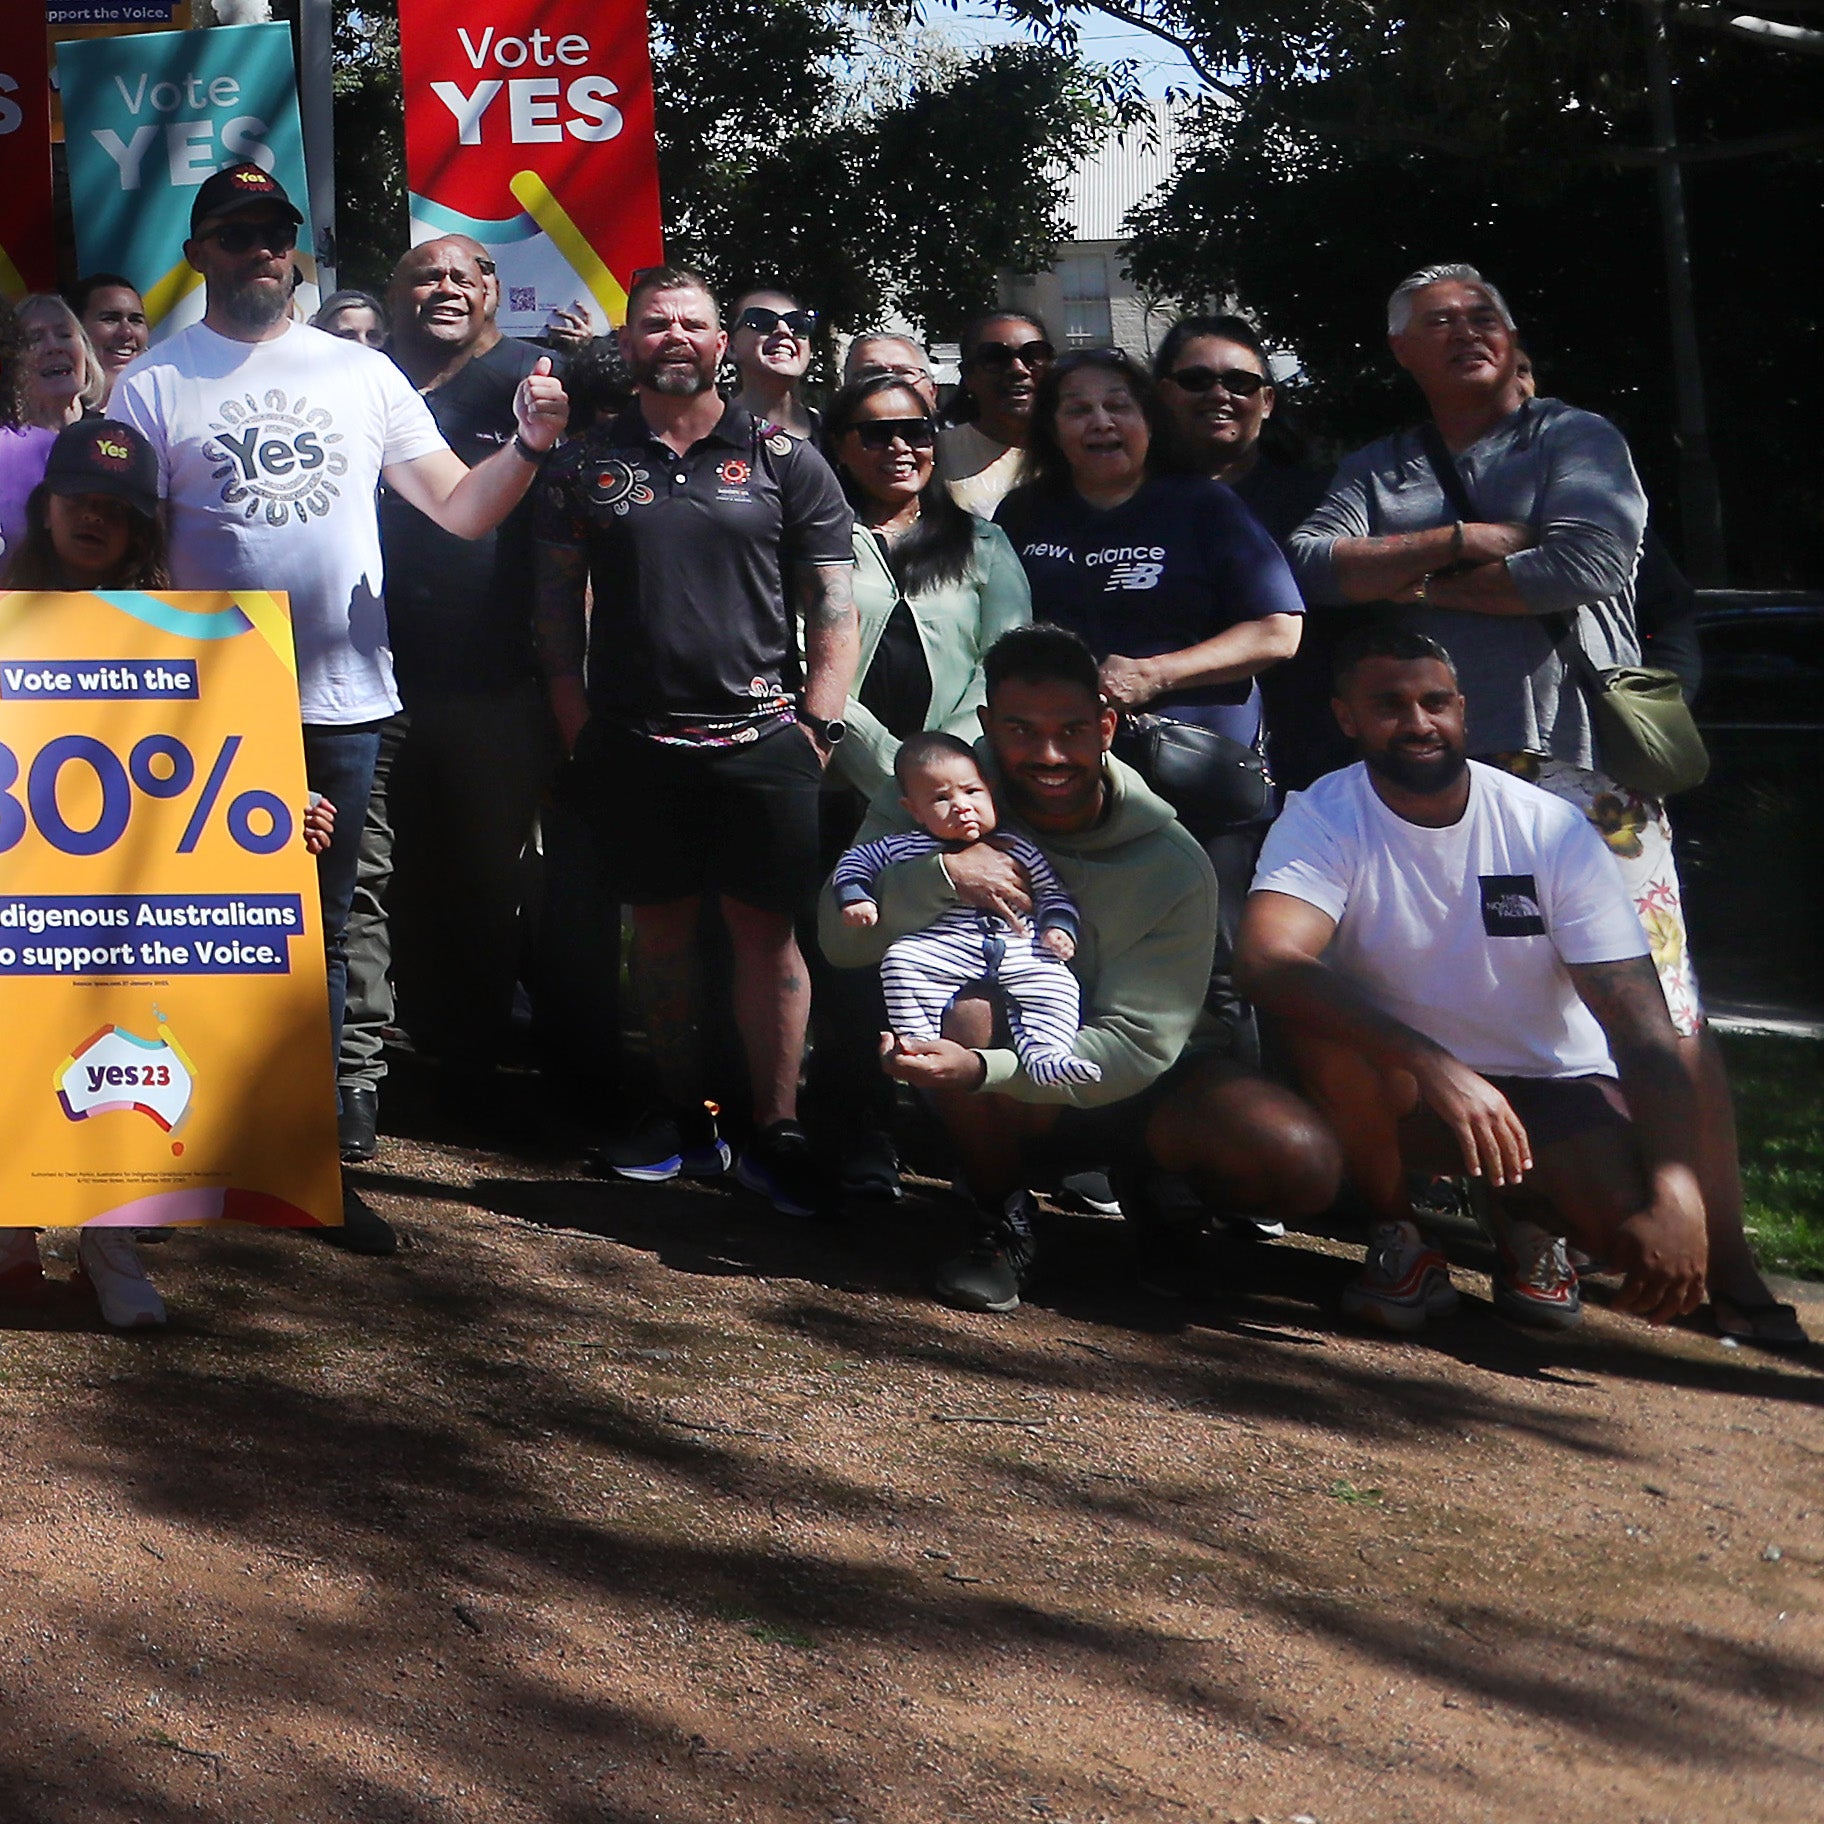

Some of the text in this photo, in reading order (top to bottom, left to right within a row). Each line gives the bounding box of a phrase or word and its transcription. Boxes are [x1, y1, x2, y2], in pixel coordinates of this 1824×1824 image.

[93, 7, 120, 19] the
[125, 5, 170, 19] Voice.
[457, 27, 589, 69] Vote
[117, 74, 240, 114] Vote
[430, 76, 623, 144] YES
[92, 116, 275, 189] YES
[97, 440, 127, 458] Yes
[214, 424, 323, 481] Yes
[1022, 542, 1069, 559] new
[3, 667, 191, 691] Vote with the
[135, 902, 296, 926] Australians
[23, 944, 134, 971] support
[139, 940, 189, 965] the
[193, 940, 282, 964] Voice.
[86, 1066, 170, 1092] yes23
